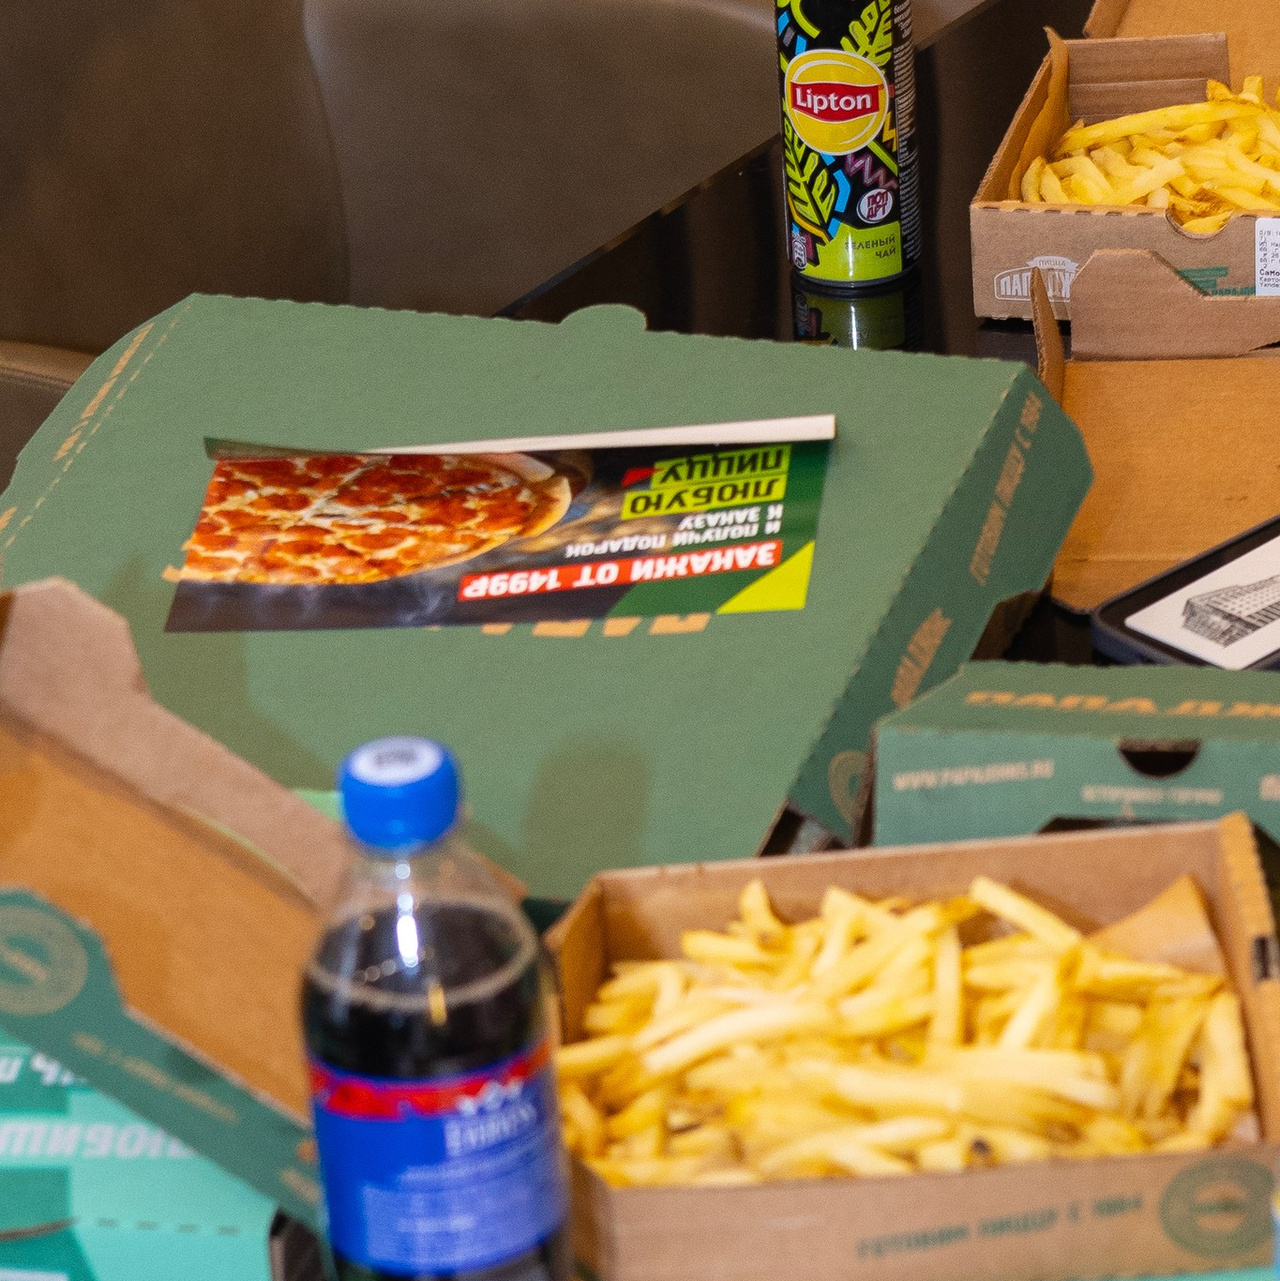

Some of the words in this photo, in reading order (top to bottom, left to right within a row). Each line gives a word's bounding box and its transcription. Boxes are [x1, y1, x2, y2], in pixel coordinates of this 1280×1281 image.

[796, 86, 872, 115] Lipton
[875, 245, 897, 260] ЧАЙ
[1001, 272, 1032, 296] ПАП
[660, 447, 784, 483] ПИЦЦУ
[628, 477, 781, 514] ЛЮБУЮ
[678, 506, 761, 530] ЗАКАЗУ
[766, 502, 783, 520] К
[671, 523, 758, 544] ПОЛУЧИ
[764, 520, 781, 535] И
[565, 533, 666, 558] ПОДАРОК
[573, 561, 619, 588] ОТ
[631, 543, 777, 582] ЗАКАЖИ
[462, 568, 562, 598] 1499₽
[963, 691, 1156, 714] ПАПА
